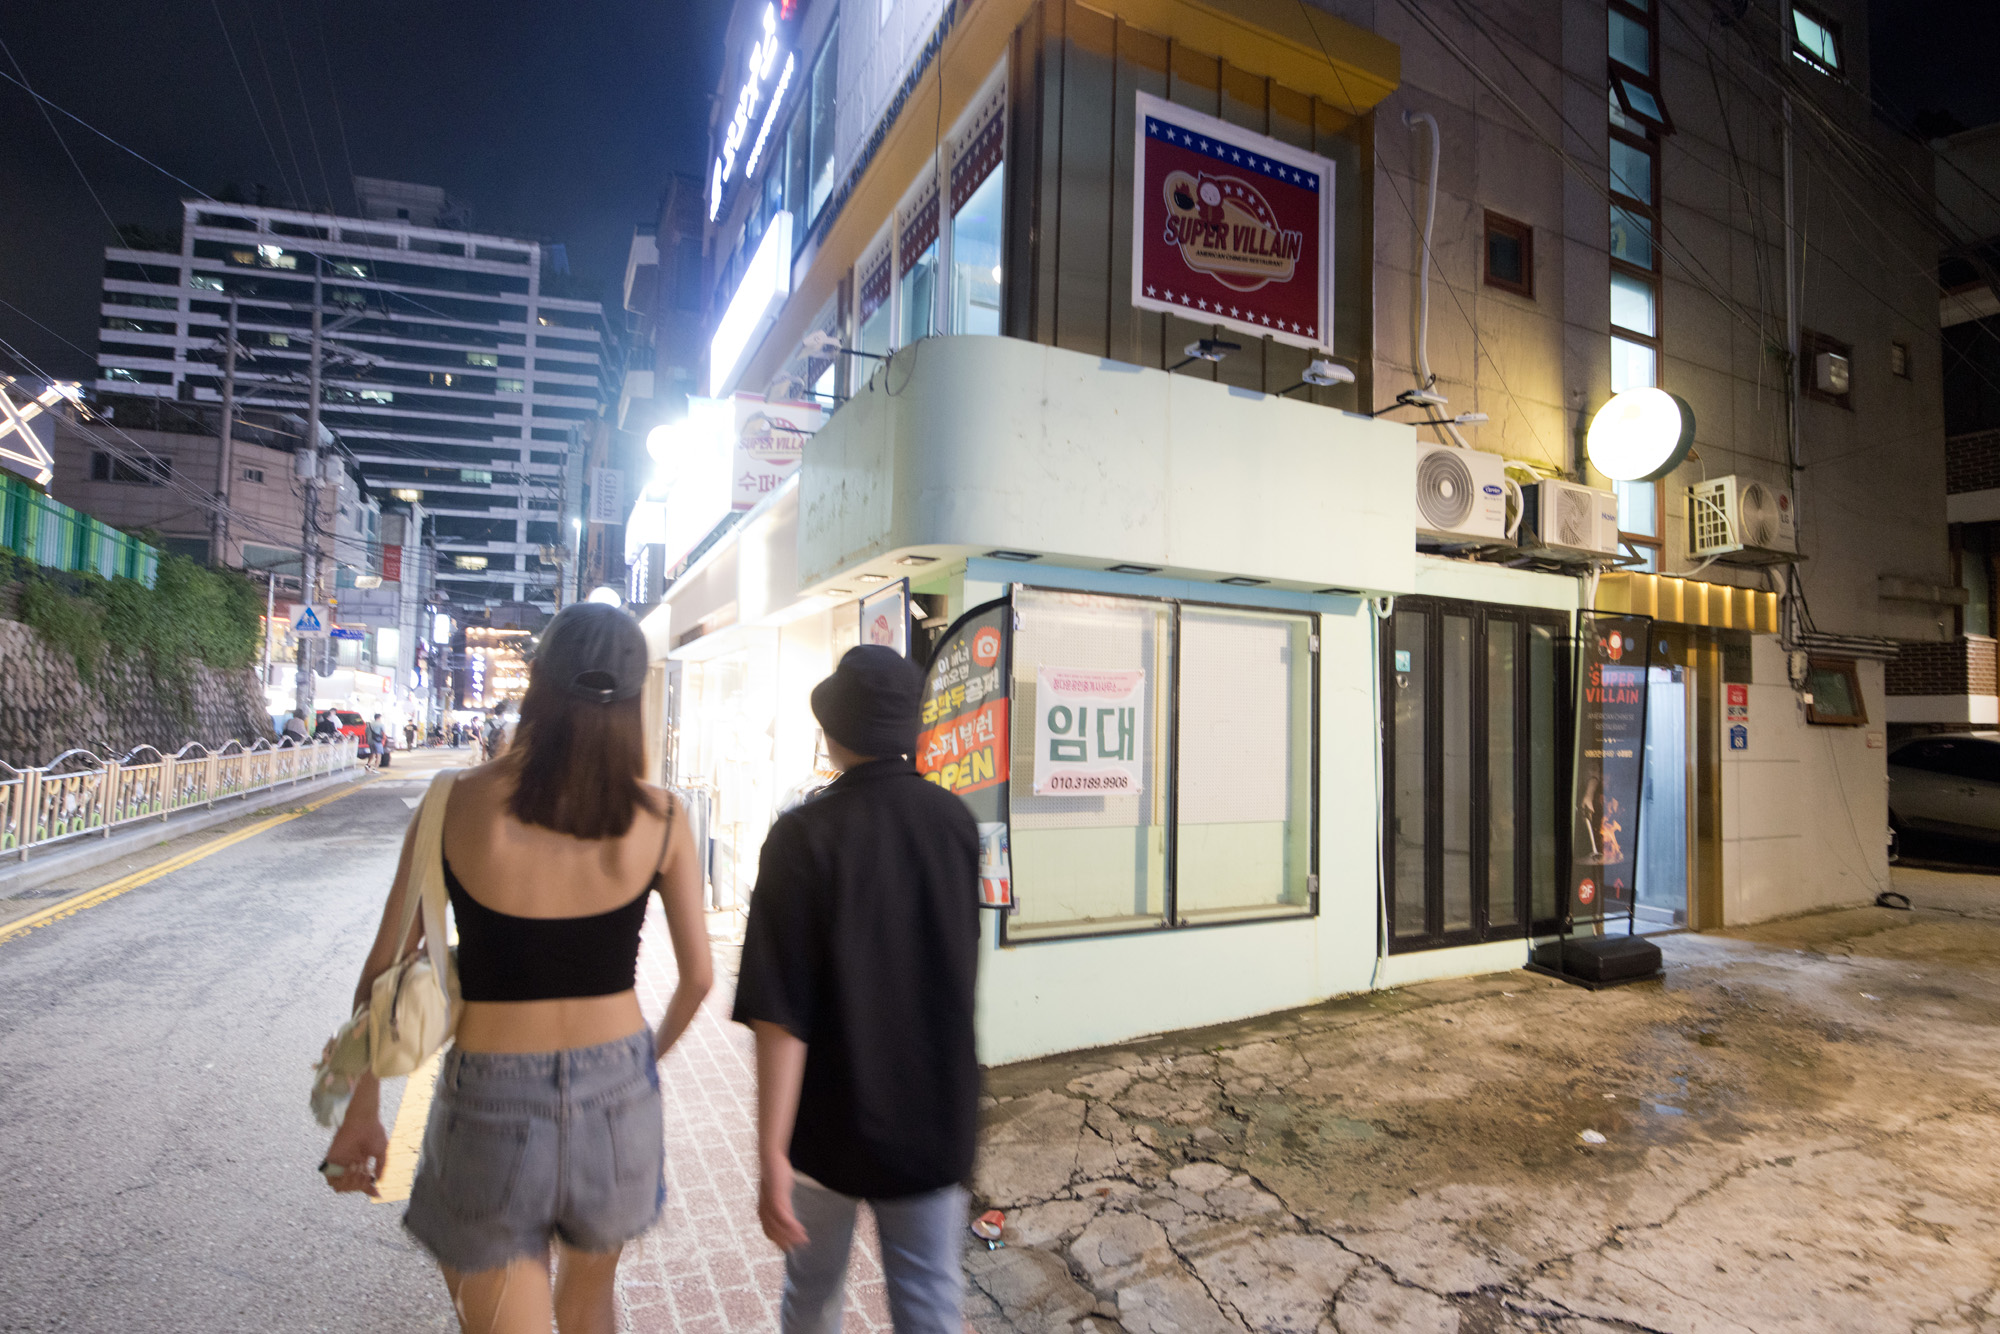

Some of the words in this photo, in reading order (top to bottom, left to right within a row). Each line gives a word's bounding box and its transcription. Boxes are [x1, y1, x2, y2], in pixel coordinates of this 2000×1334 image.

[1164, 214, 1230, 251] SUPER
[1233, 223, 1301, 261] VILLAIN
[739, 437, 774, 450] SUPER
[738, 471, 785, 493] 수퍼
[937, 656, 950, 674] 이
[1591, 670, 1635, 688] SUPER
[1585, 687, 1639, 705] VILLAIN
[1047, 705, 1135, 762] 임대
[1051, 776, 1128, 790] 010.3189.9908
[1581, 884, 1593, 899] 2F
